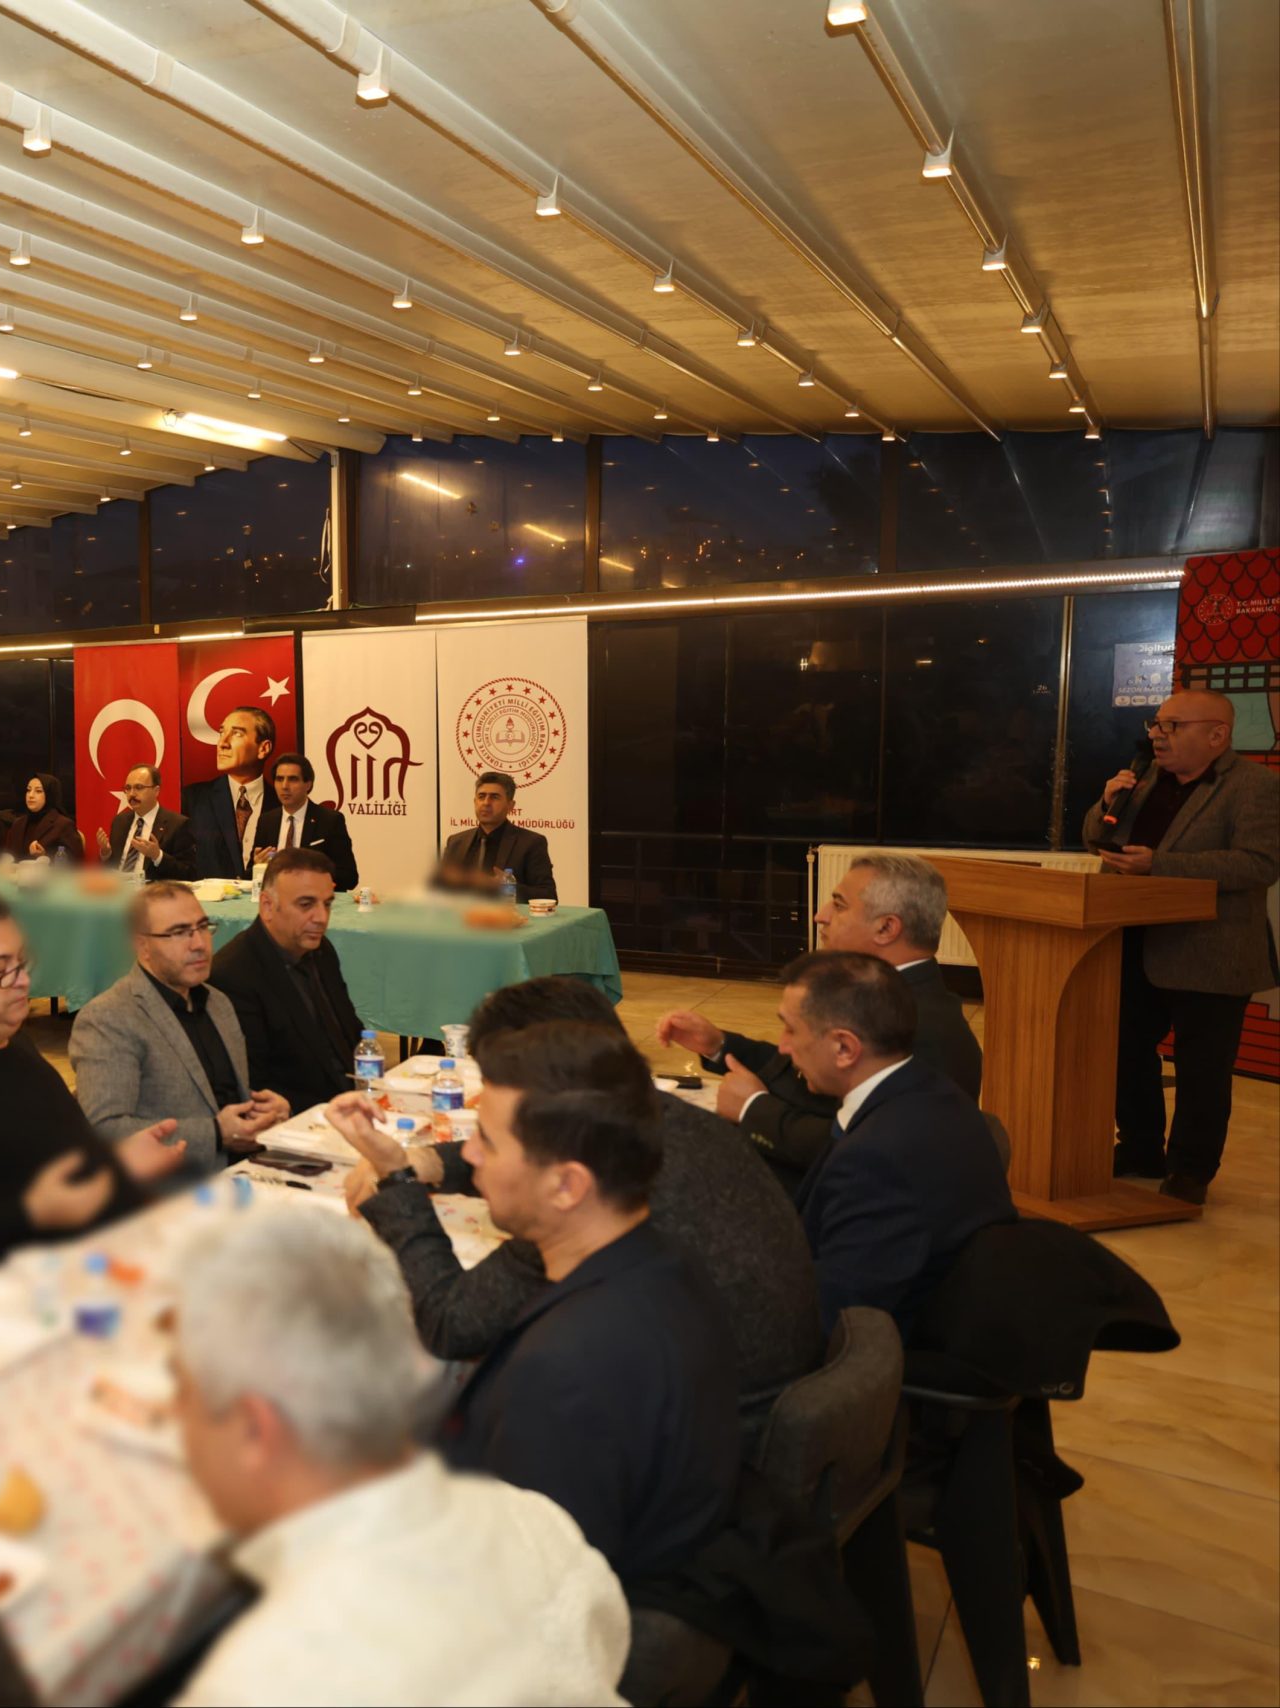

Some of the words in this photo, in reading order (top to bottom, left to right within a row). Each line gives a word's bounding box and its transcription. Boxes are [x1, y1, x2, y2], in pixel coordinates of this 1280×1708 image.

[508, 698, 528, 708] MİLLİ
[348, 801, 407, 816] VALİLİĞİ
[450, 817, 458, 827] İL
[518, 818, 575, 829] MÜDÜRLÜĞÜ
